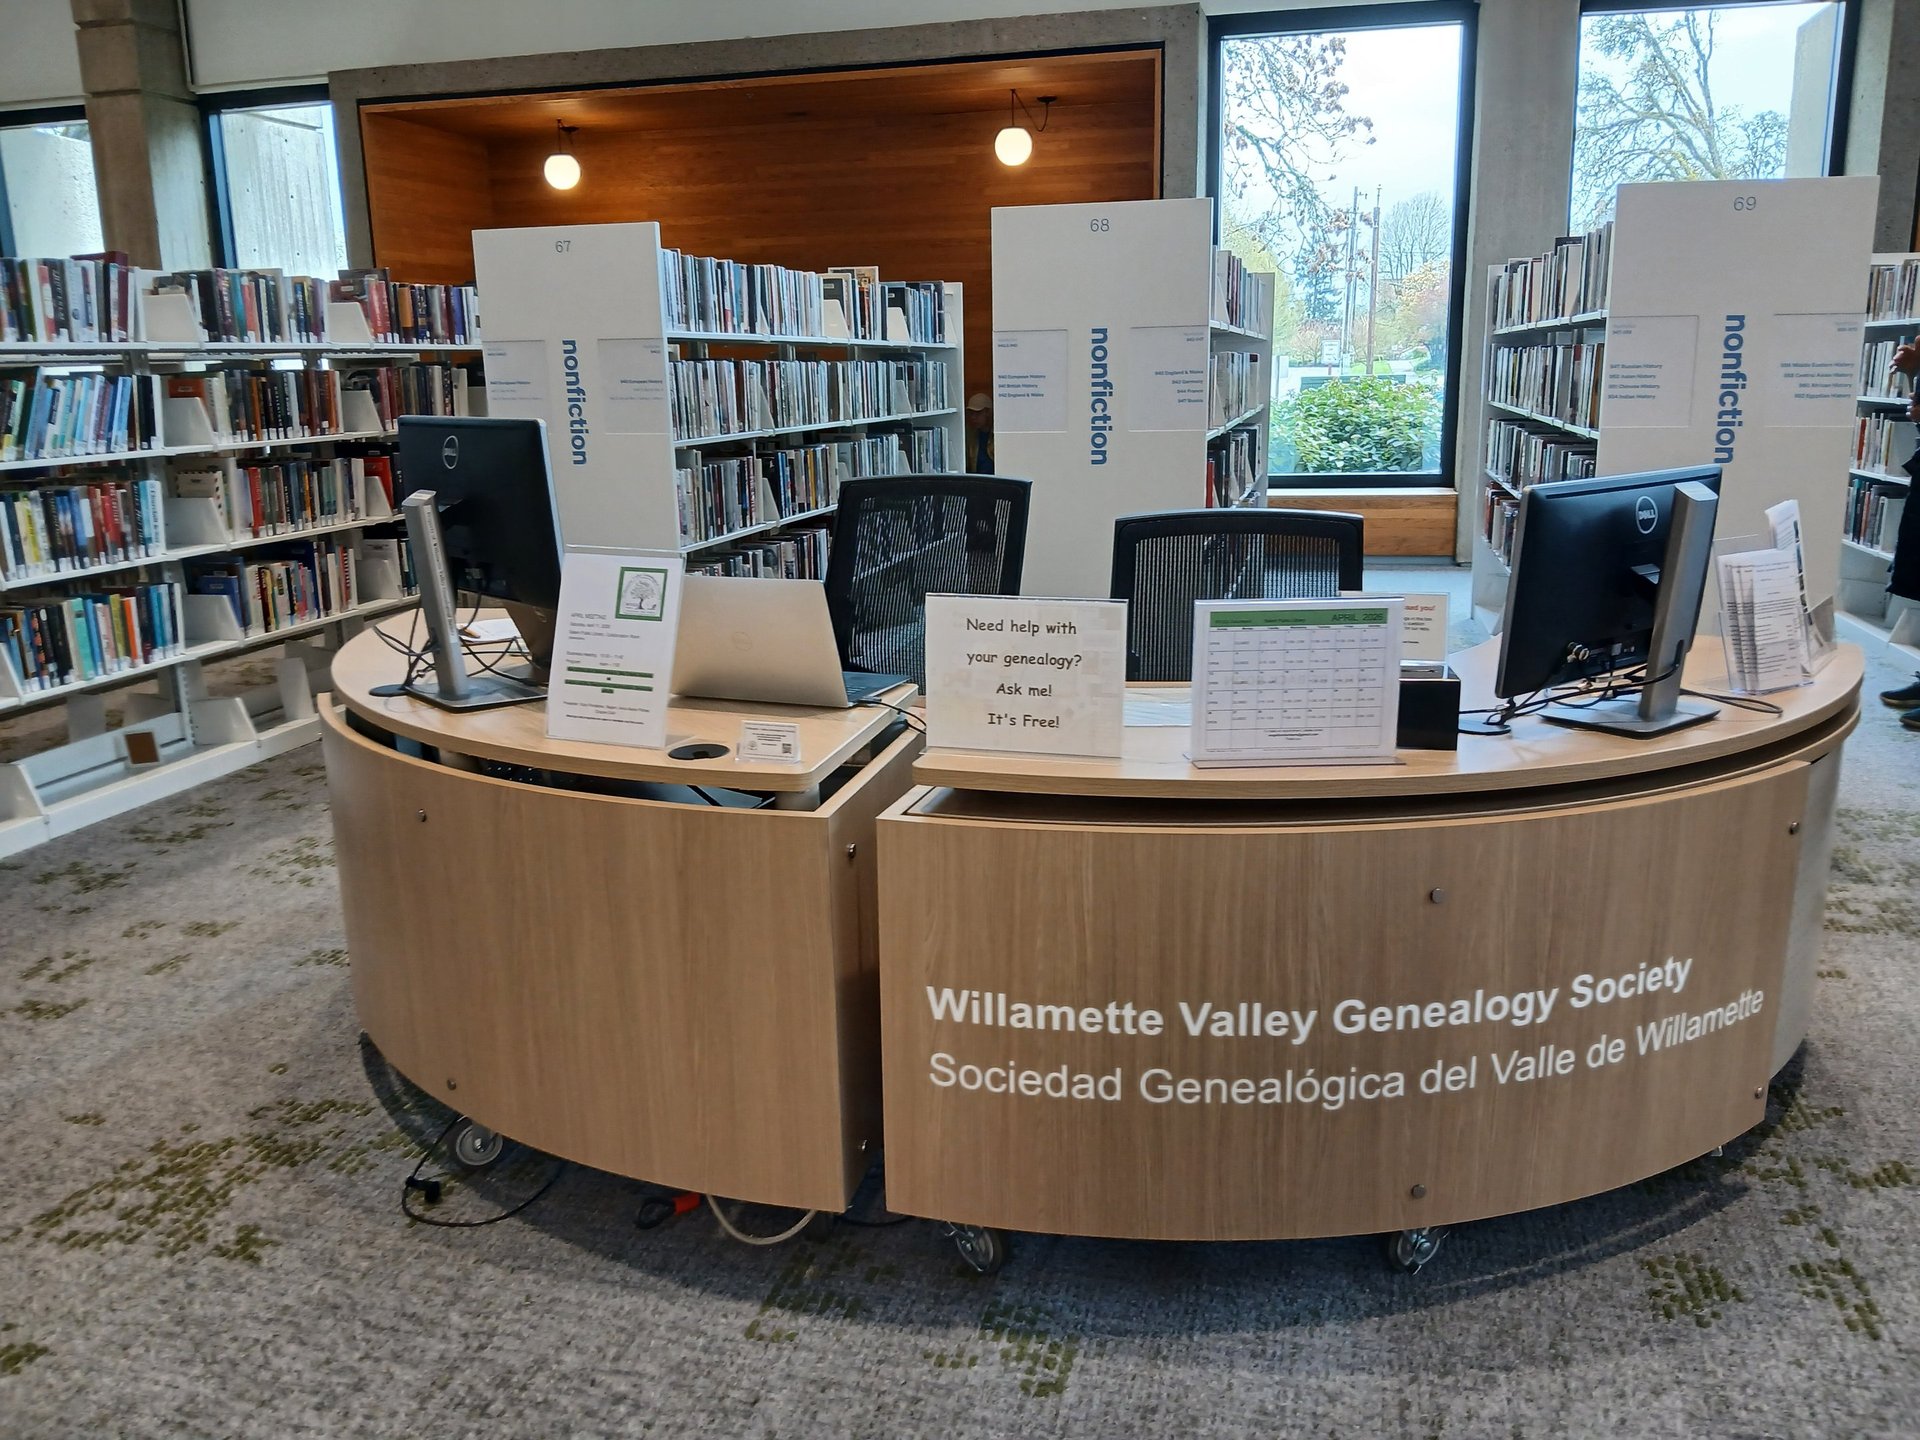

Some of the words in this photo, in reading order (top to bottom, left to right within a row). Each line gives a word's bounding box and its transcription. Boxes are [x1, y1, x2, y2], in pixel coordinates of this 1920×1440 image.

[1733, 196, 1757, 211] 69
[1090, 218, 1110, 232] 68
[555, 240, 571, 253] 67
[1090, 328, 1114, 465] nonfiction
[1713, 314, 1747, 464] nonfiction
[562, 339, 590, 465] nonfiction
[1331, 614, 1359, 622] APRIL
[966, 618, 1004, 632] Need
[1010, 620, 1040, 637] help
[1046, 622, 1077, 634] with
[966, 653, 998, 666] your
[1004, 652, 1082, 670] genealogy?
[996, 682, 1022, 696] Ask
[1028, 684, 1052, 697] me!
[987, 712, 1017, 726] It's
[1023, 714, 1060, 728] Free!
[926, 986, 1164, 1035] Willamette
[1179, 1001, 1318, 1046] Valley
[1333, 987, 1559, 1035] Genealogy
[1570, 955, 1693, 1008] Society
[928, 1052, 1122, 1101] Sociedad
[1139, 1066, 1405, 1111] Genealógica
[1419, 1056, 1478, 1094] del
[1490, 1044, 1576, 1085] Valle
[1586, 1034, 1626, 1069] de
[1635, 988, 1765, 1057] Willamette
